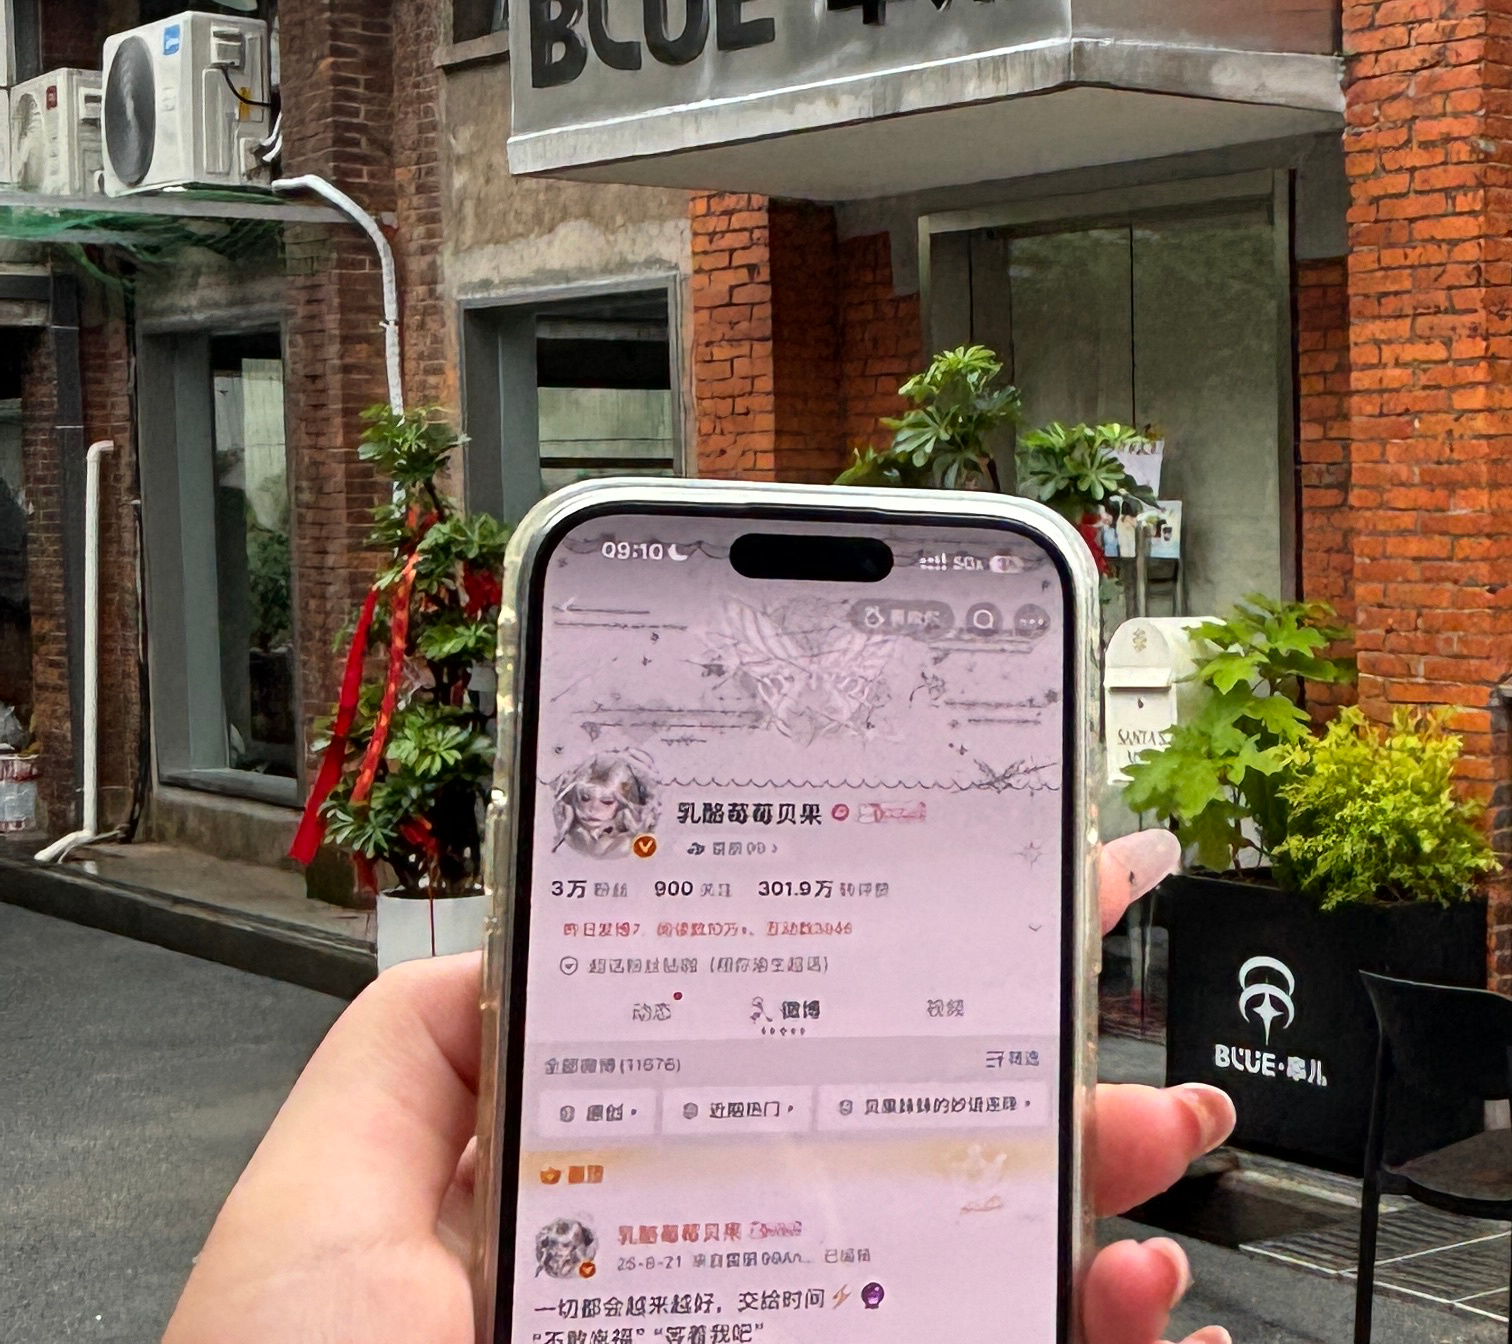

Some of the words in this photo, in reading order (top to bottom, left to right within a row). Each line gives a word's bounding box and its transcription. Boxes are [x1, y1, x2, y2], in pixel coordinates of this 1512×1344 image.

[601, 541, 664, 561] 09:10
[551, 879, 588, 898] 3万
[654, 880, 694, 897] 900
[758, 880, 834, 899] 301.9万
